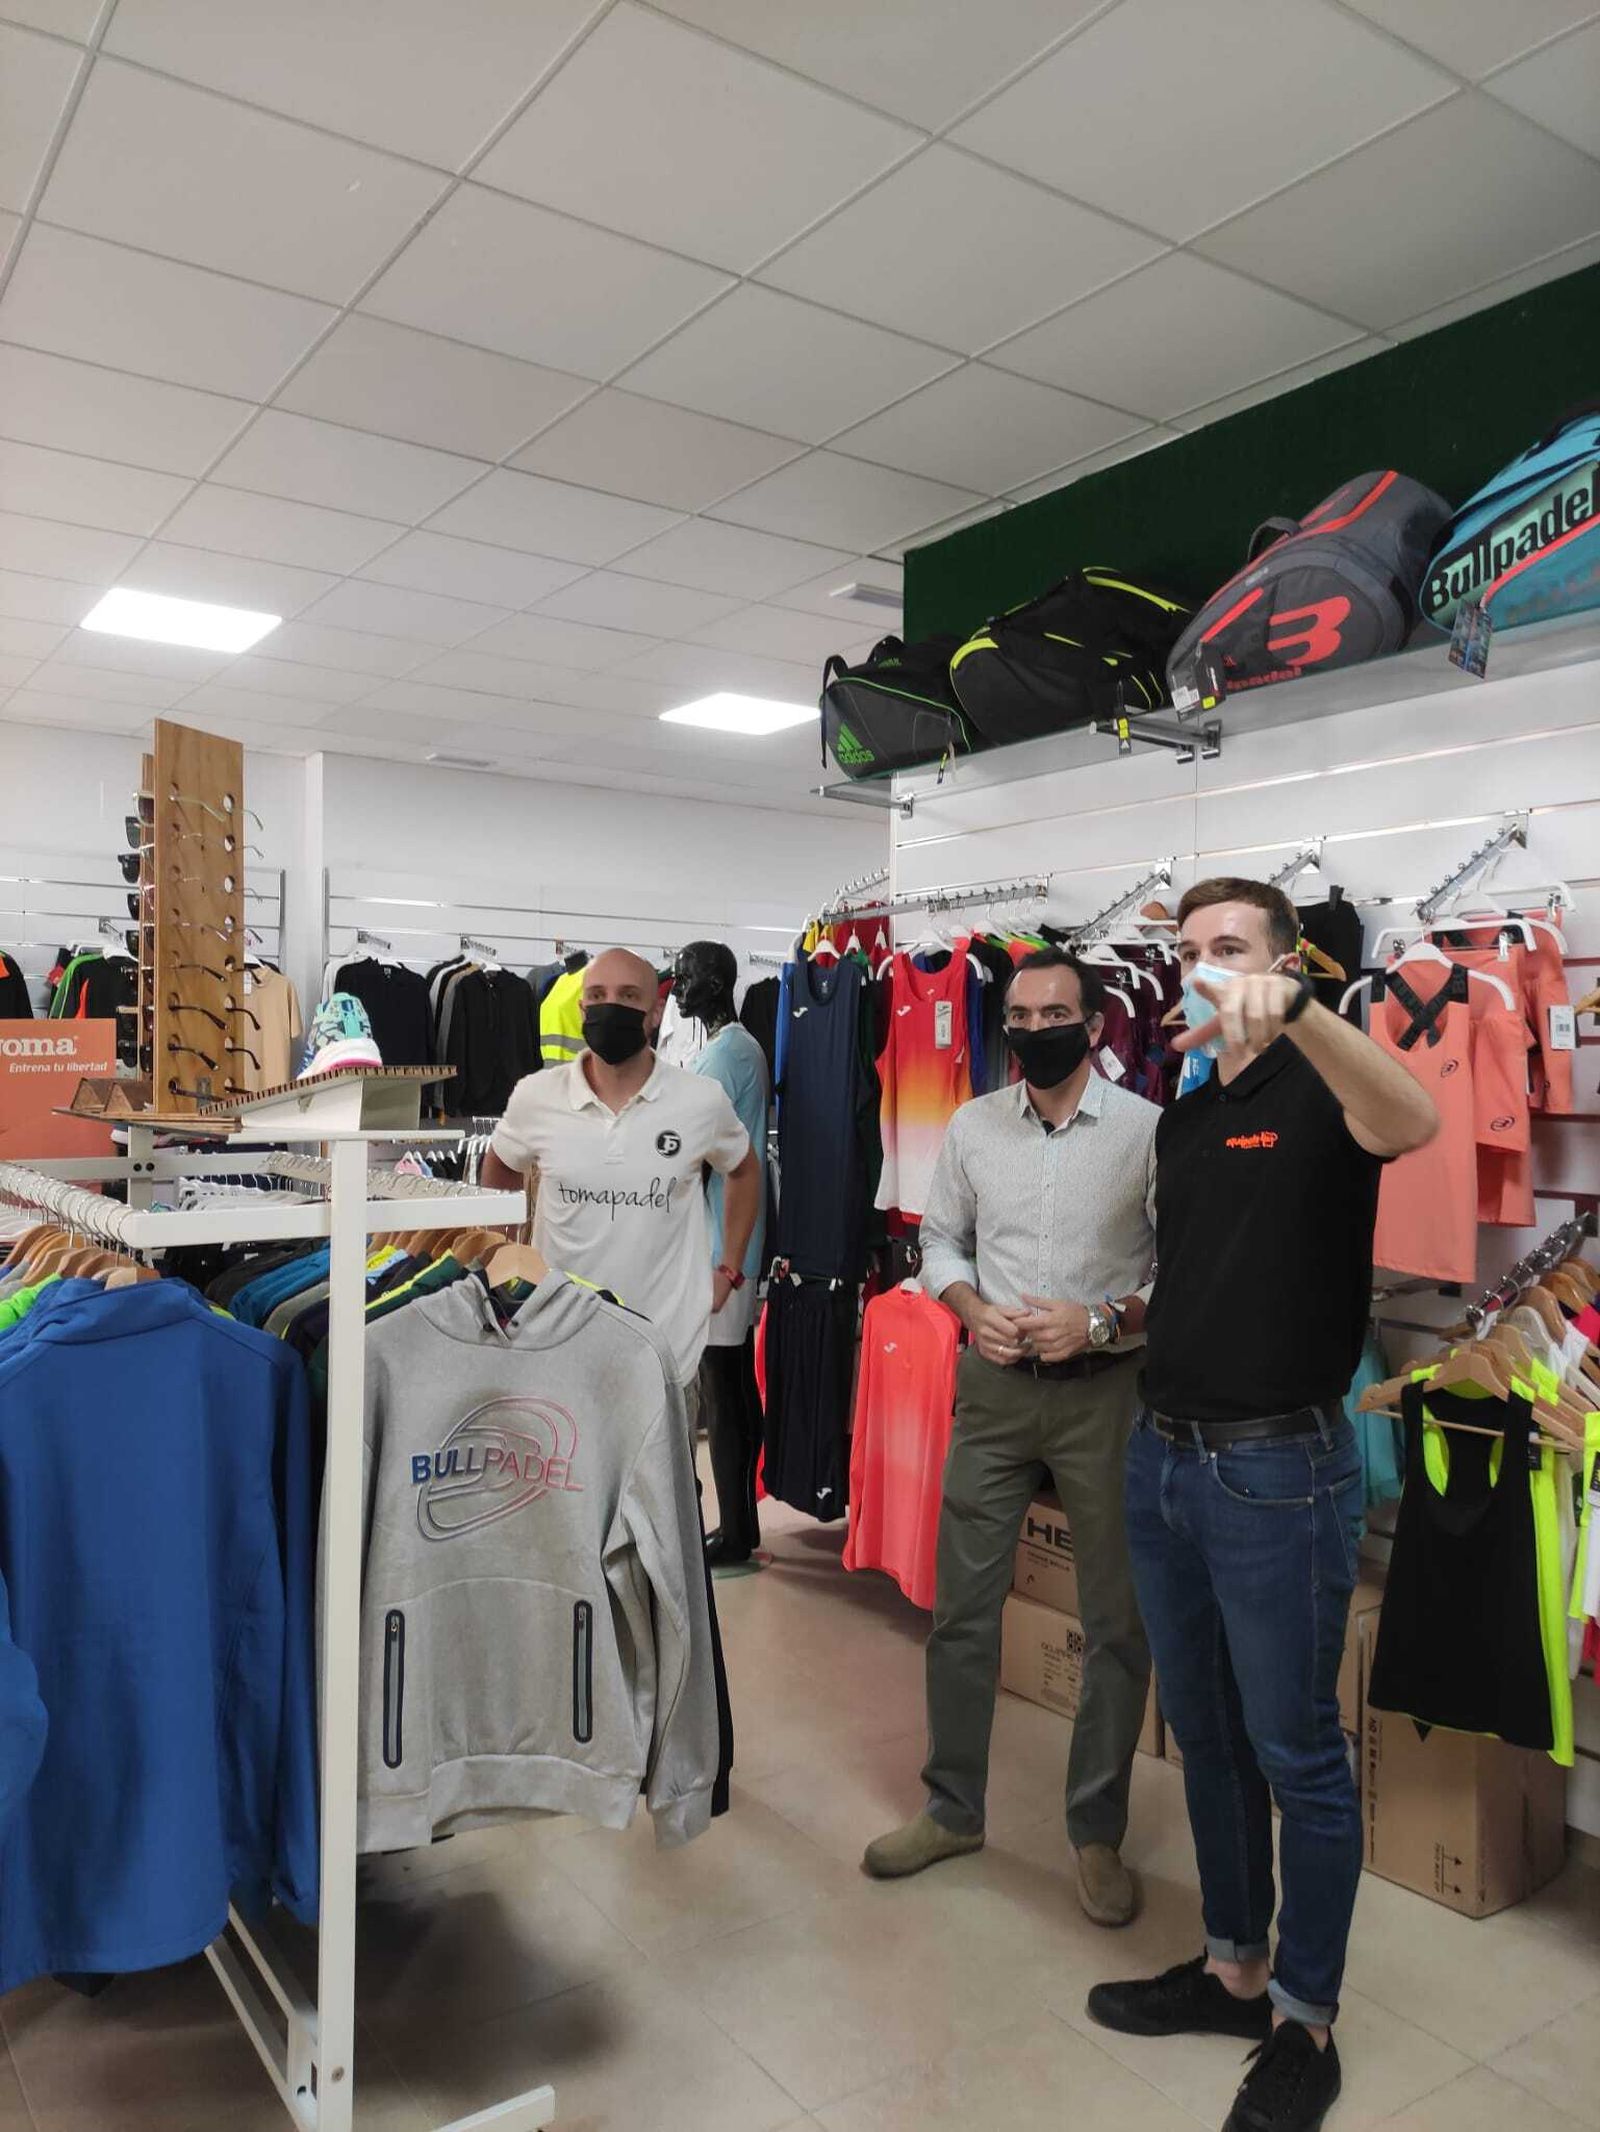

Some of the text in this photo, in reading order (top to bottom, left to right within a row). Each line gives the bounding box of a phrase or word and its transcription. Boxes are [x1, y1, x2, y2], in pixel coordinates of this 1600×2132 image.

[0, 1037, 77, 1057] oma
[9, 1061, 108, 1073] Entrena tu libertad
[558, 1176, 678, 1222] tomapadel
[411, 1445, 585, 1493] BULLPADEL
